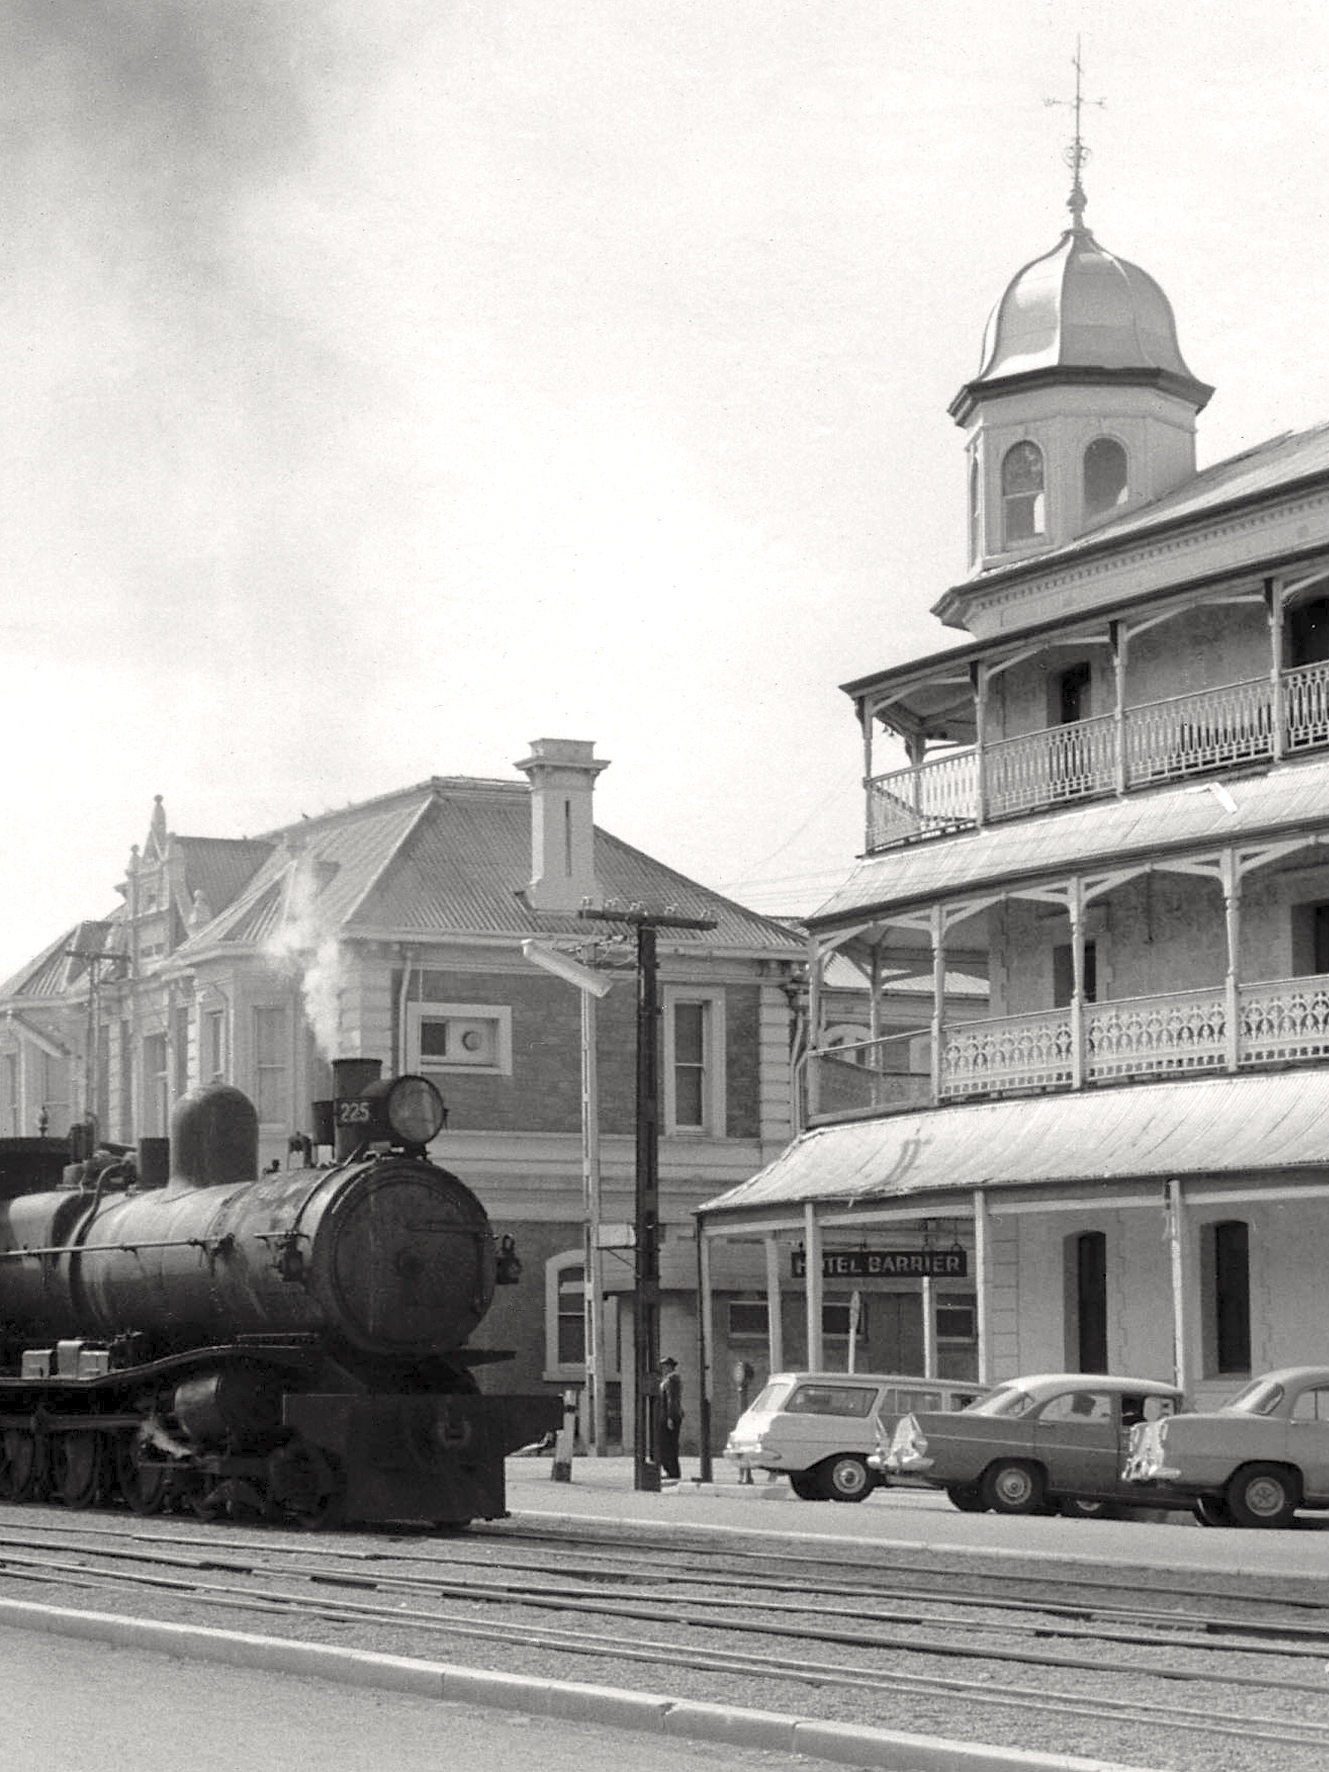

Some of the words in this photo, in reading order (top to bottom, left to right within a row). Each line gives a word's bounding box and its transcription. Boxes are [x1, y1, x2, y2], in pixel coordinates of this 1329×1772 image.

[340, 1101, 370, 1122] 225
[796, 1256, 862, 1274] HTEL
[868, 1255, 960, 1273] BARRIER
